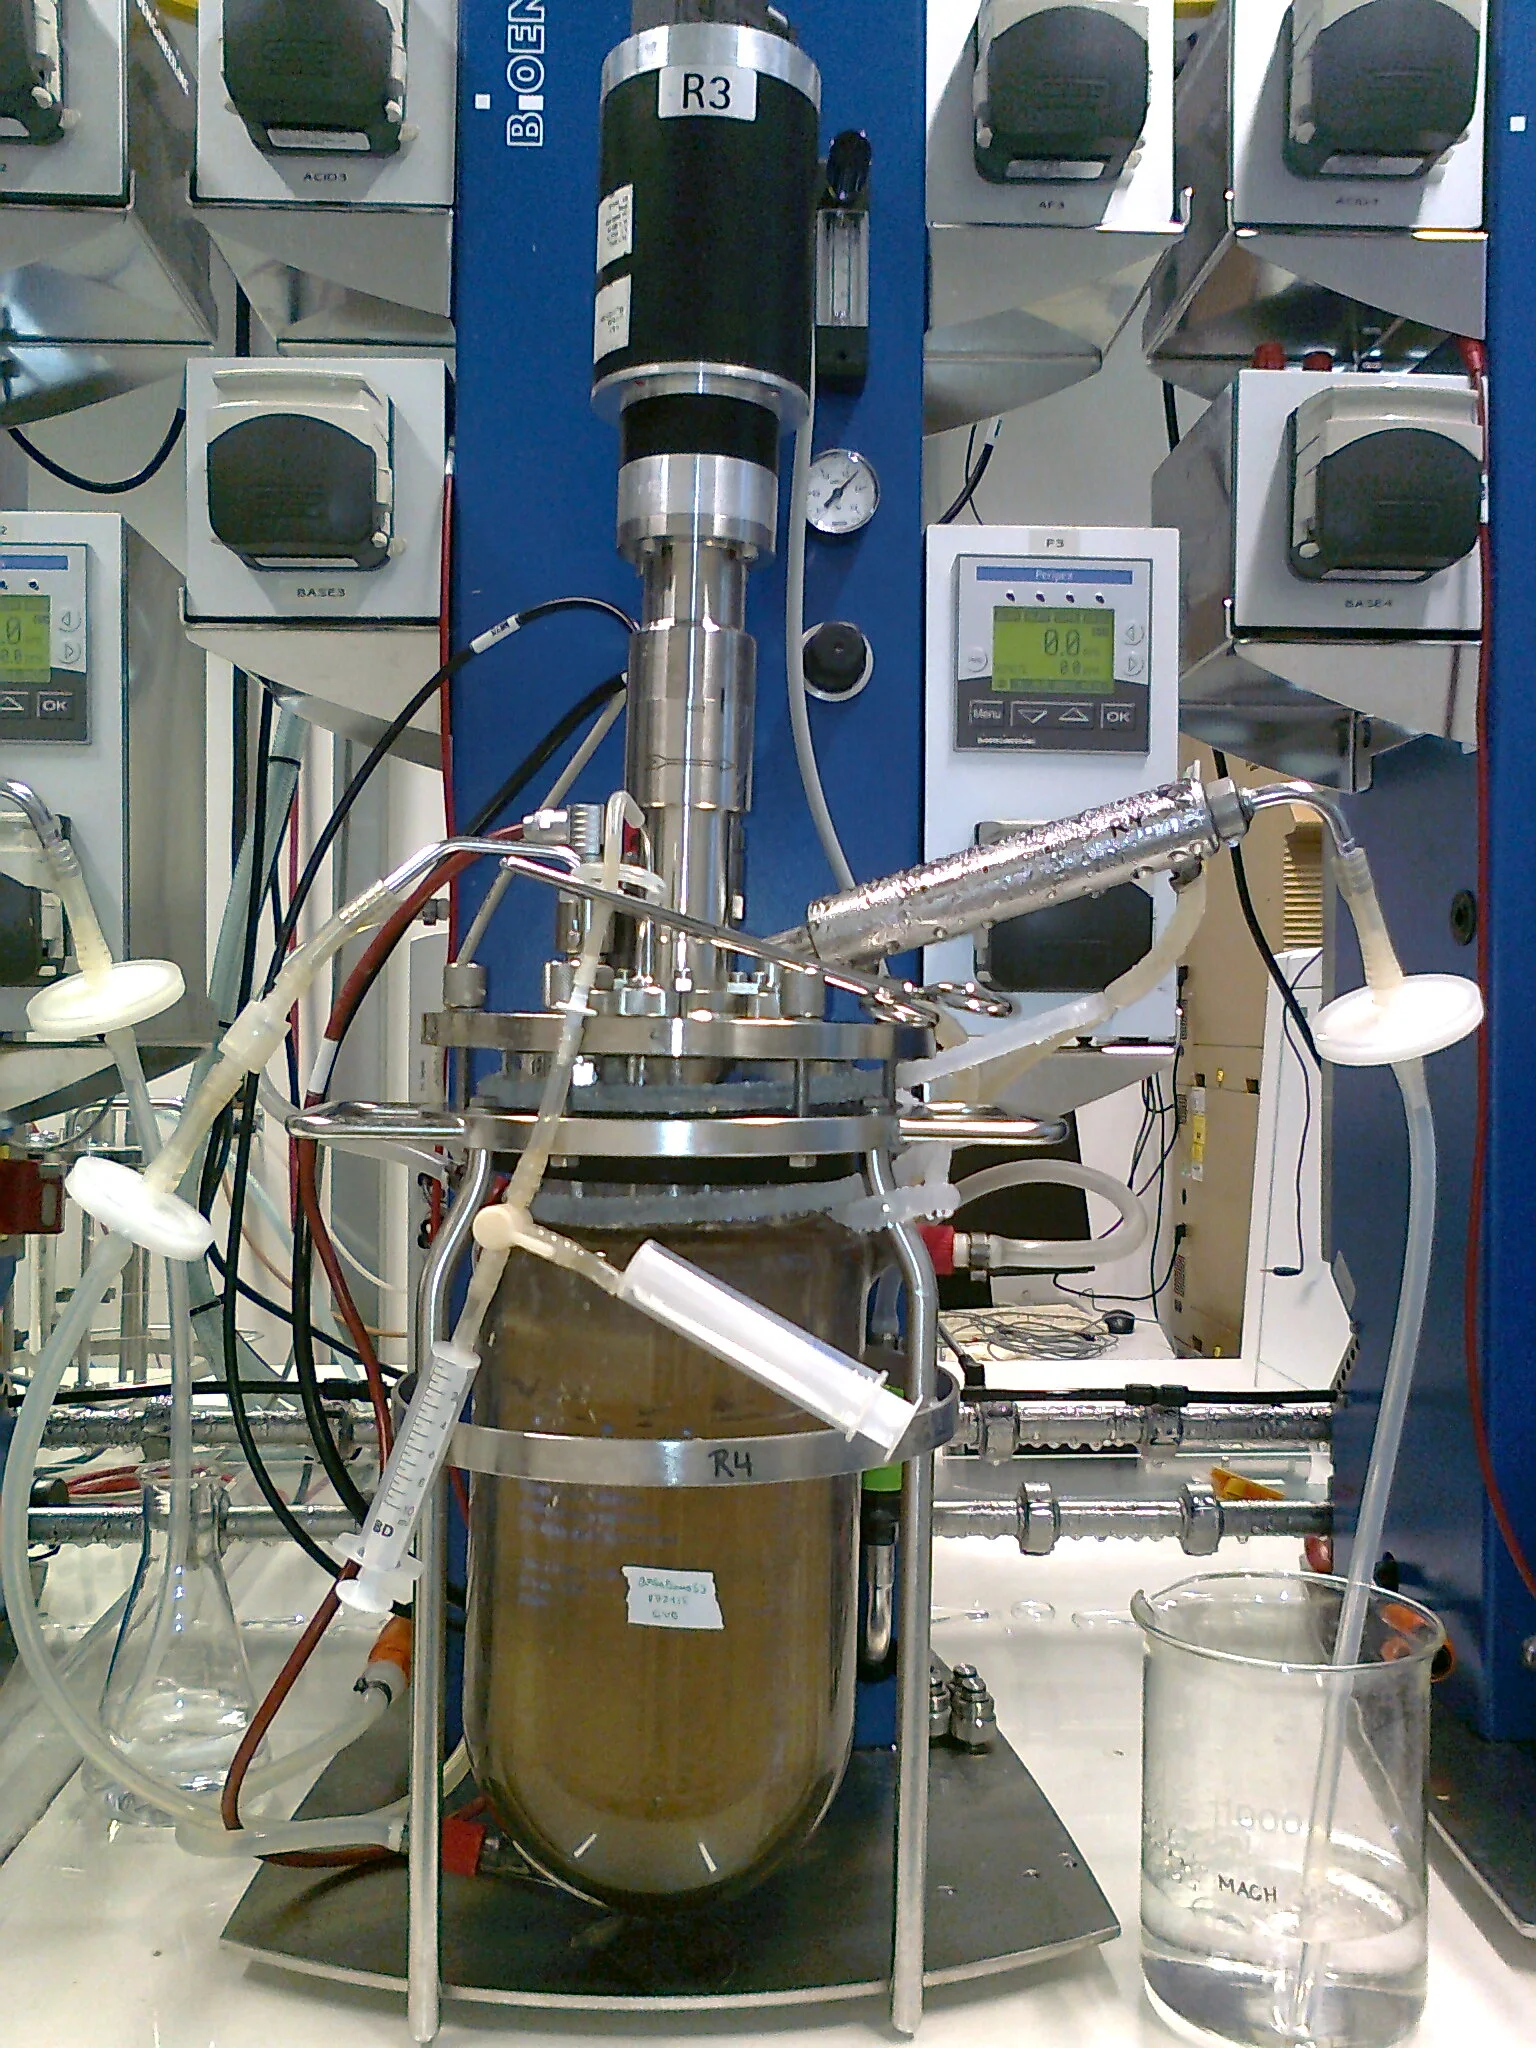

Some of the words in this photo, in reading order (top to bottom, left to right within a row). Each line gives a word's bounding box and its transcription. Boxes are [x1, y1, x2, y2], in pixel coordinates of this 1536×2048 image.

[682, 73, 731, 109] R3
[296, 587, 346, 598] BASE3
[42, 699, 68, 713] OK
[973, 708, 1001, 720] Menu
[1106, 711, 1131, 723] OK
[708, 1448, 753, 1478] R4
[372, 1518, 395, 1539] BD
[1217, 1873, 1278, 1903] MACH
